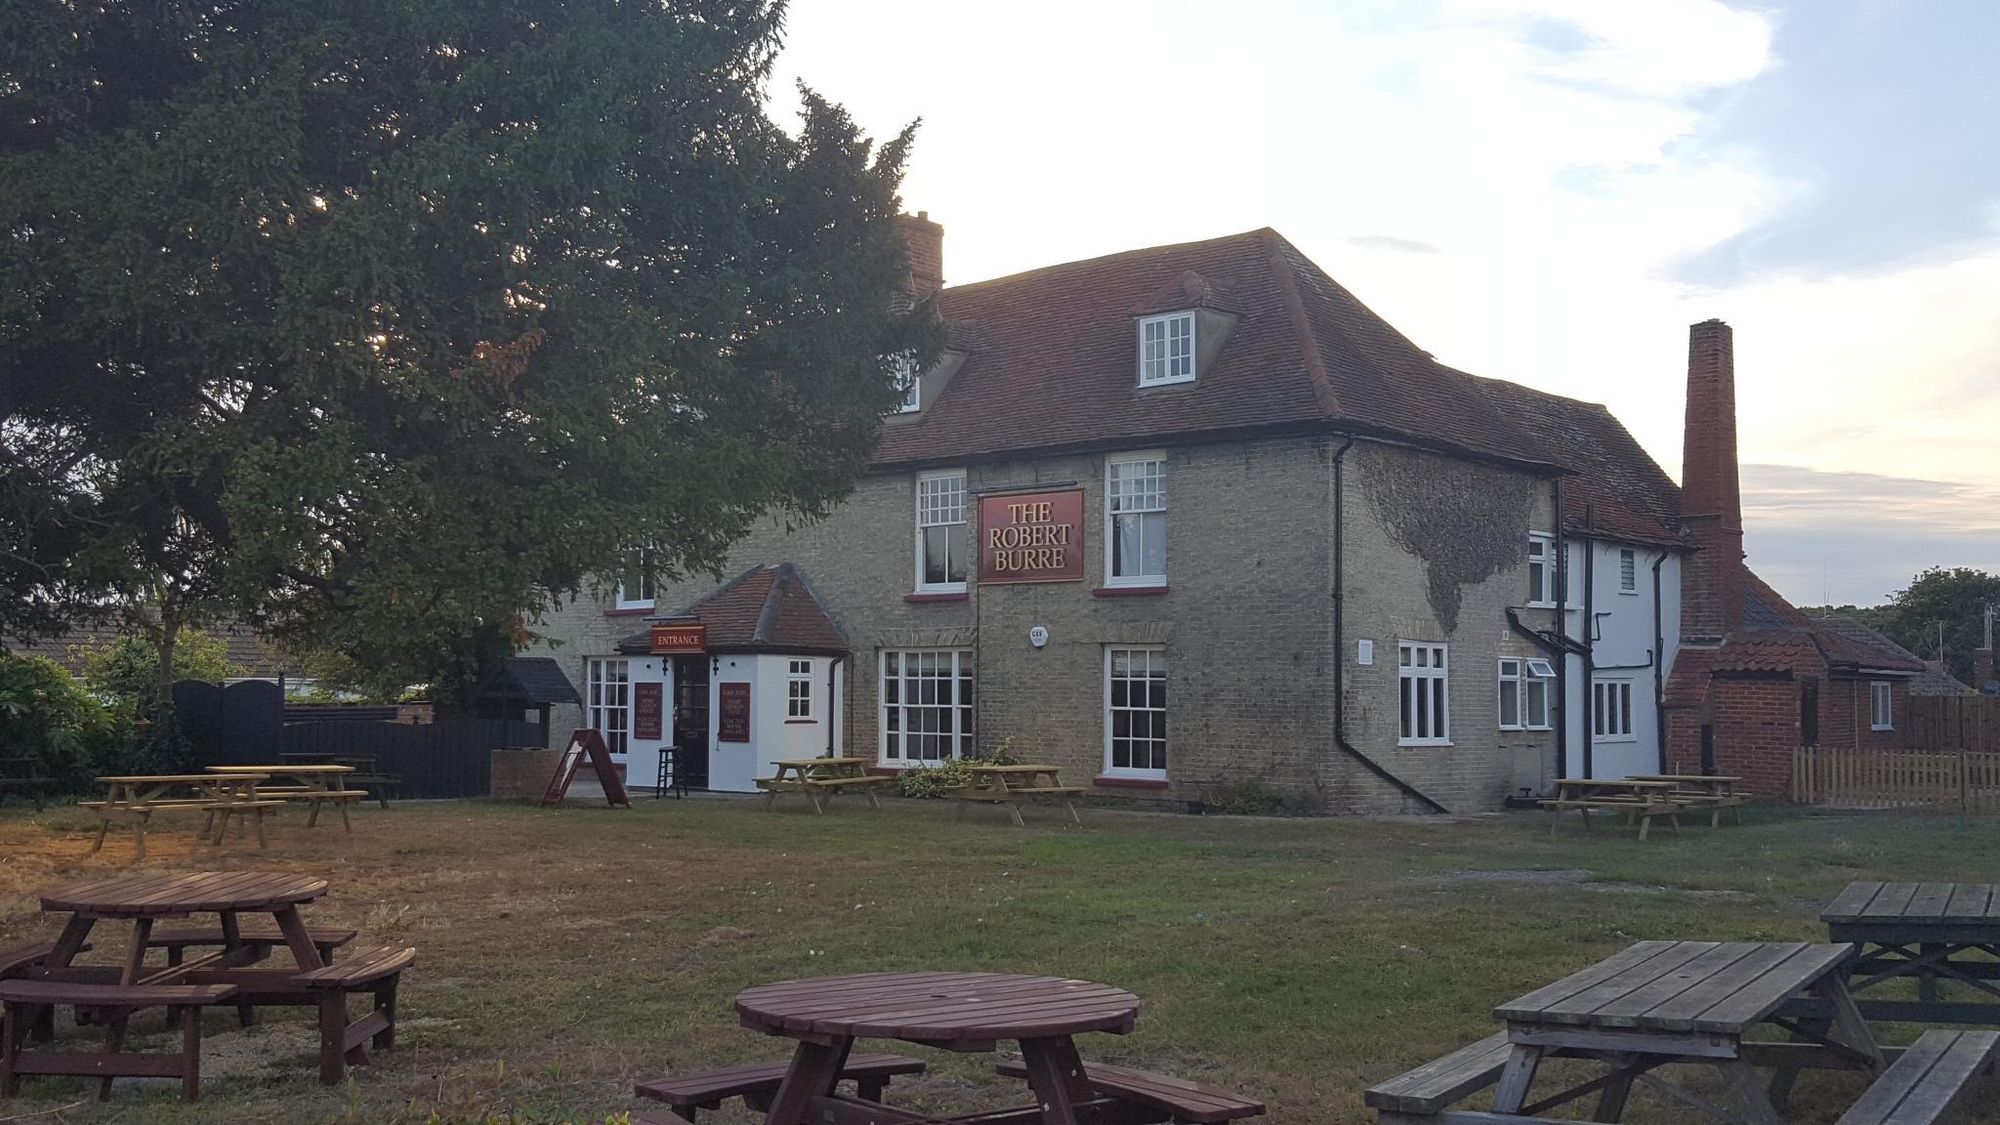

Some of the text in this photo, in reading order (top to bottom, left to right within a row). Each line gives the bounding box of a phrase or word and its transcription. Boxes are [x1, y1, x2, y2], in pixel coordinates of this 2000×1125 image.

[1008, 502, 1052, 524] THE
[988, 523, 1071, 548] ROBERT
[995, 548, 1065, 571] BURRE
[658, 635, 700, 646] ENTRANCE
